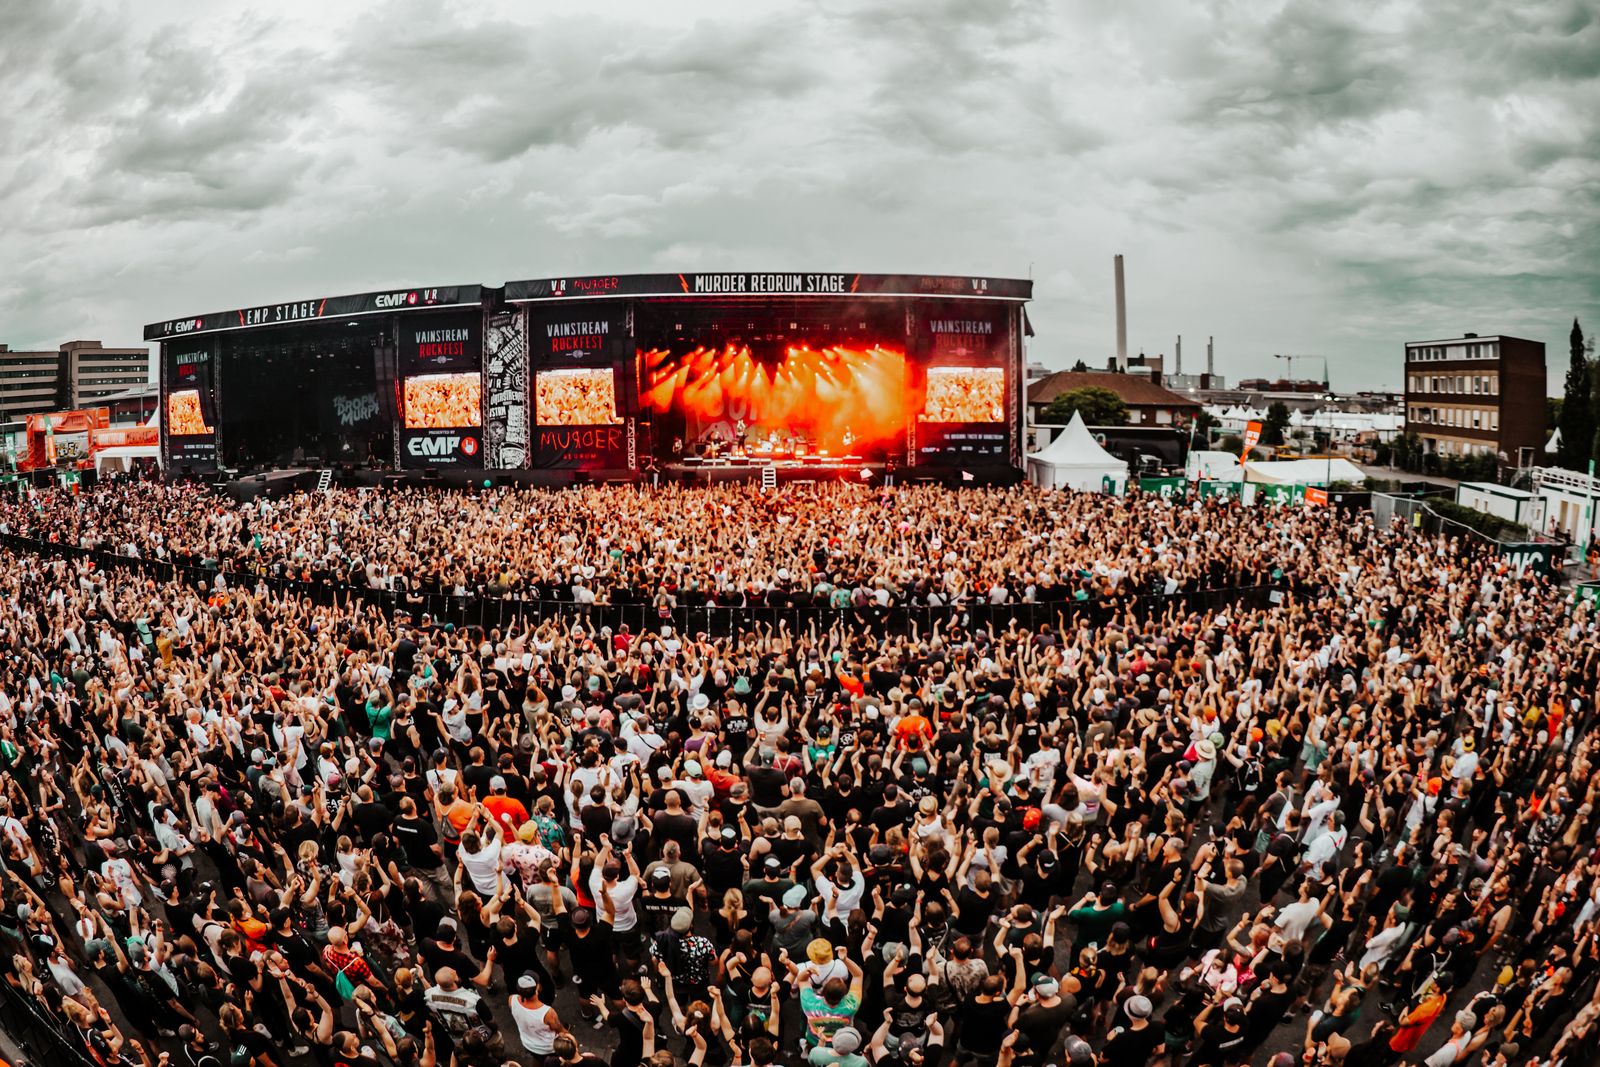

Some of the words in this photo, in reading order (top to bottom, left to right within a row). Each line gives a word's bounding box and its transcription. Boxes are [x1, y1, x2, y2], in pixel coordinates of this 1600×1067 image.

[695, 274, 746, 292] MURDER
[751, 274, 801, 292] REDRUM
[807, 274, 845, 292] STAGE
[375, 292, 408, 307] EMP
[247, 308, 269, 325] EMP
[276, 301, 316, 321] STAGE
[175, 319, 196, 333] EMP
[547, 321, 609, 337] VAINSTREAM
[929, 320, 992, 334] VAINSTREAM
[415, 328, 469, 343] VAINSTREAM
[551, 335, 603, 352] ROCKFEST
[420, 341, 464, 358] ROCKFEST
[407, 436, 460, 456] EMP
[540, 428, 620, 451] MURDER
